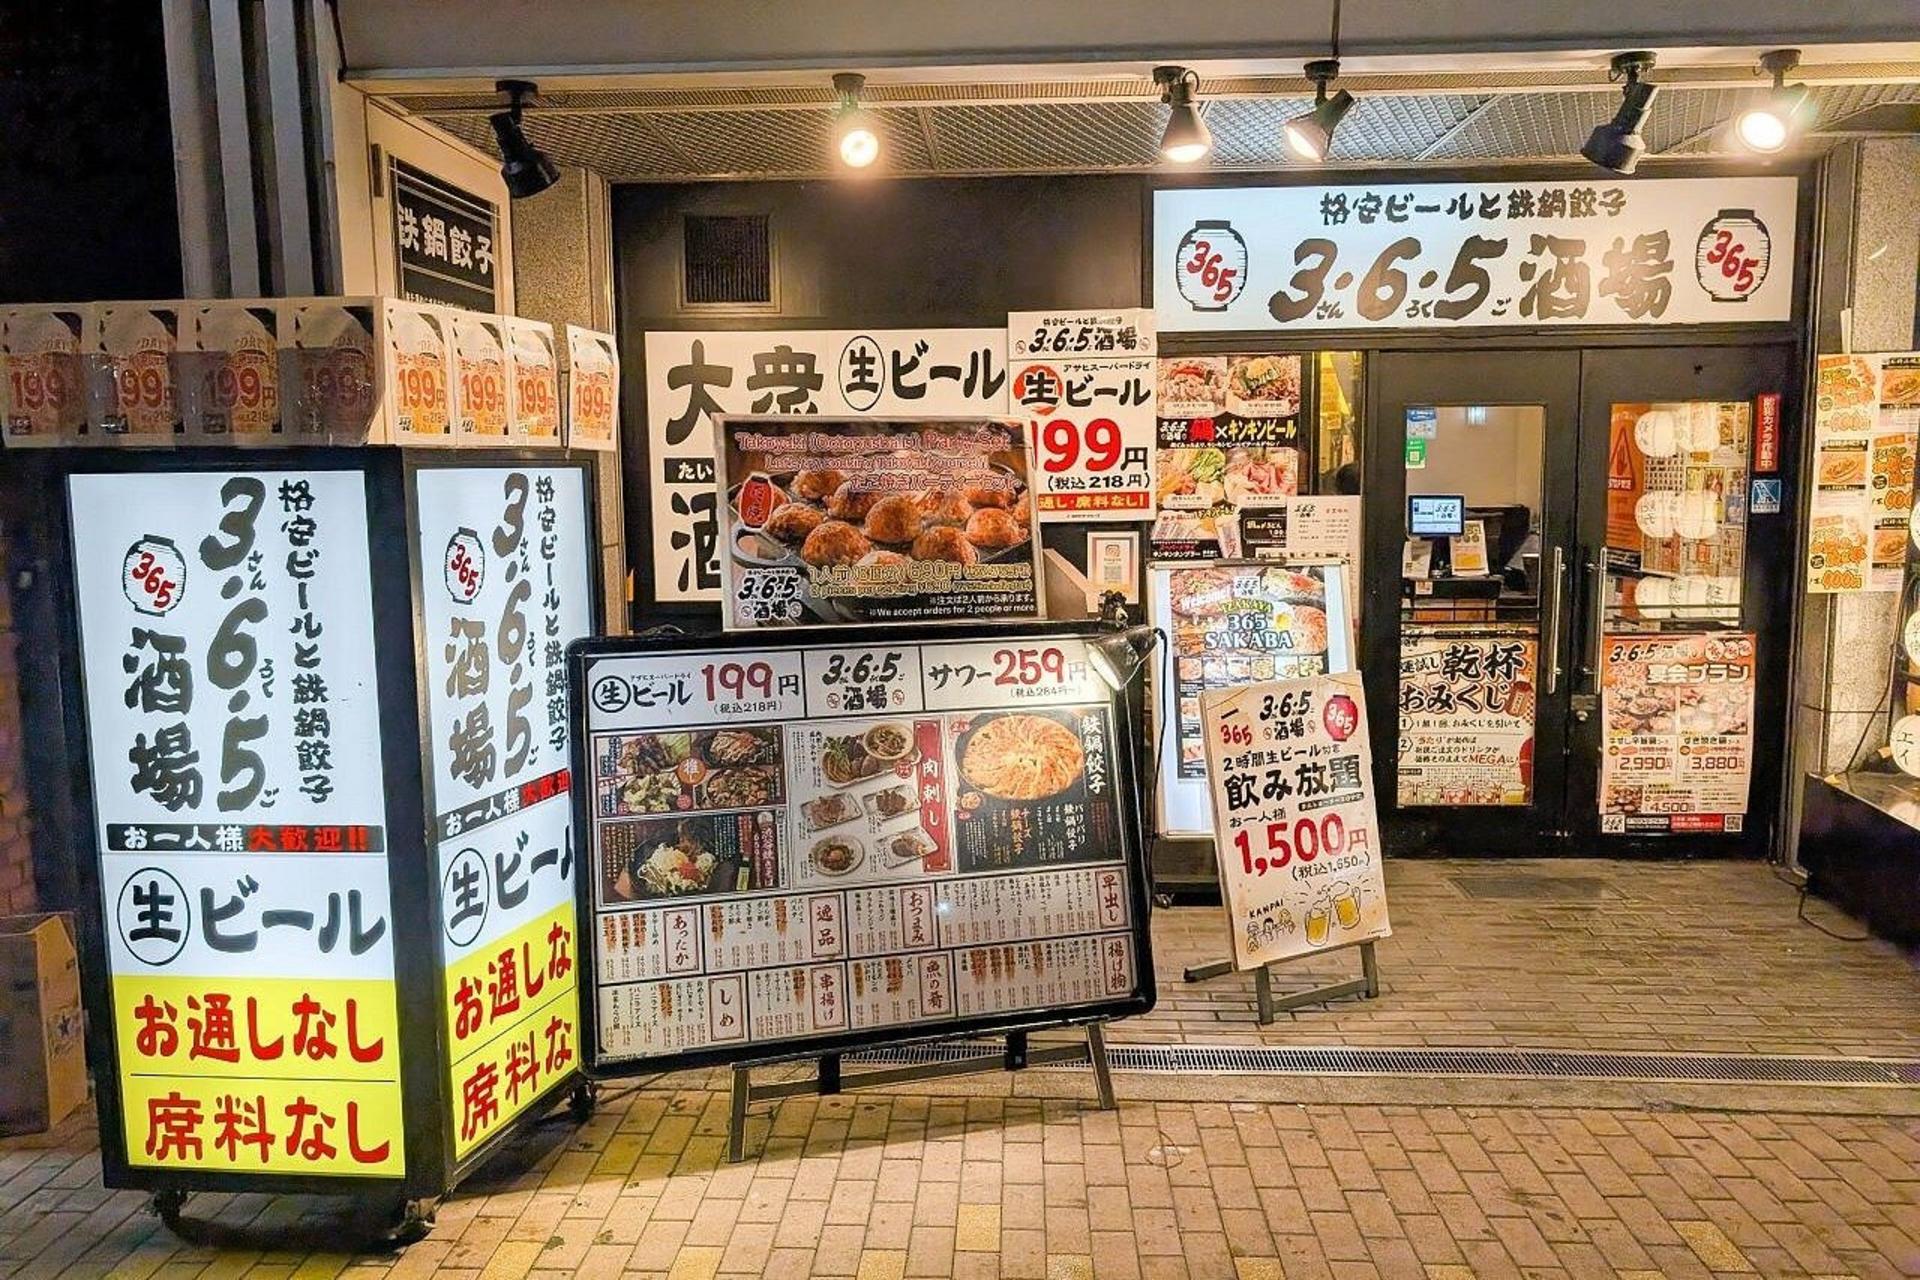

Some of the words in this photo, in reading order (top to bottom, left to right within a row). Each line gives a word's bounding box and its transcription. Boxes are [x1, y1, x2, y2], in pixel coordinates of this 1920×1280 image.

[1319, 187, 1627, 225] 格安ビールと鉄鍋餃子
[1186, 239, 1238, 302] 365
[1705, 229, 1758, 293] 365
[839, 335, 1006, 410] 生ビール
[1017, 369, 1151, 410] 生ビール
[976, 431, 1011, 451] Set
[132, 552, 176, 608] 365
[451, 544, 479, 596] 365
[893, 608, 922, 618] accept
[924, 606, 952, 616] orders
[953, 605, 966, 614] for
[974, 605, 1002, 616] people
[1227, 612, 1268, 631] 365
[278, 479, 334, 803] 格安ビールと鉄鍋餃子
[1204, 630, 1294, 649] SAKABA
[701, 661, 800, 702] 199円
[928, 663, 992, 691] サワー
[993, 648, 1089, 686] 259円
[1442, 643, 1524, 681] 乾杯
[445, 618, 497, 790] 酒場
[592, 675, 693, 713] 生ビール
[713, 700, 783, 715] (税込218円)
[842, 684, 888, 711] 酒場
[1400, 684, 1509, 712] おみくじ
[123, 627, 204, 812] 酒場
[1220, 725, 1252, 747] 365
[1274, 716, 1305, 741] 酒場
[1327, 703, 1354, 736] 365
[1081, 714, 1107, 795] 鉄鍋餃子
[922, 757, 941, 828] 肉刺し
[1224, 754, 1363, 811] 飲み放題
[1229, 808, 1287, 828] お一人様
[1235, 813, 1370, 876] 1,500円
[117, 867, 386, 965] 生ビール
[909, 892, 925, 943] おつまみ
[1102, 874, 1120, 923] 早出し
[1249, 899, 1284, 918] KANPAI
[672, 915, 690, 967] あったか
[816, 905, 836, 947] 逸品
[926, 961, 944, 1010] 魚の肴
[1107, 941, 1127, 990] 揚げ物
[718, 989, 734, 1028] しめ
[819, 974, 836, 1021] 串揚げ
[134, 992, 385, 1064] お通しなし
[145, 1091, 391, 1164] 席料なし
